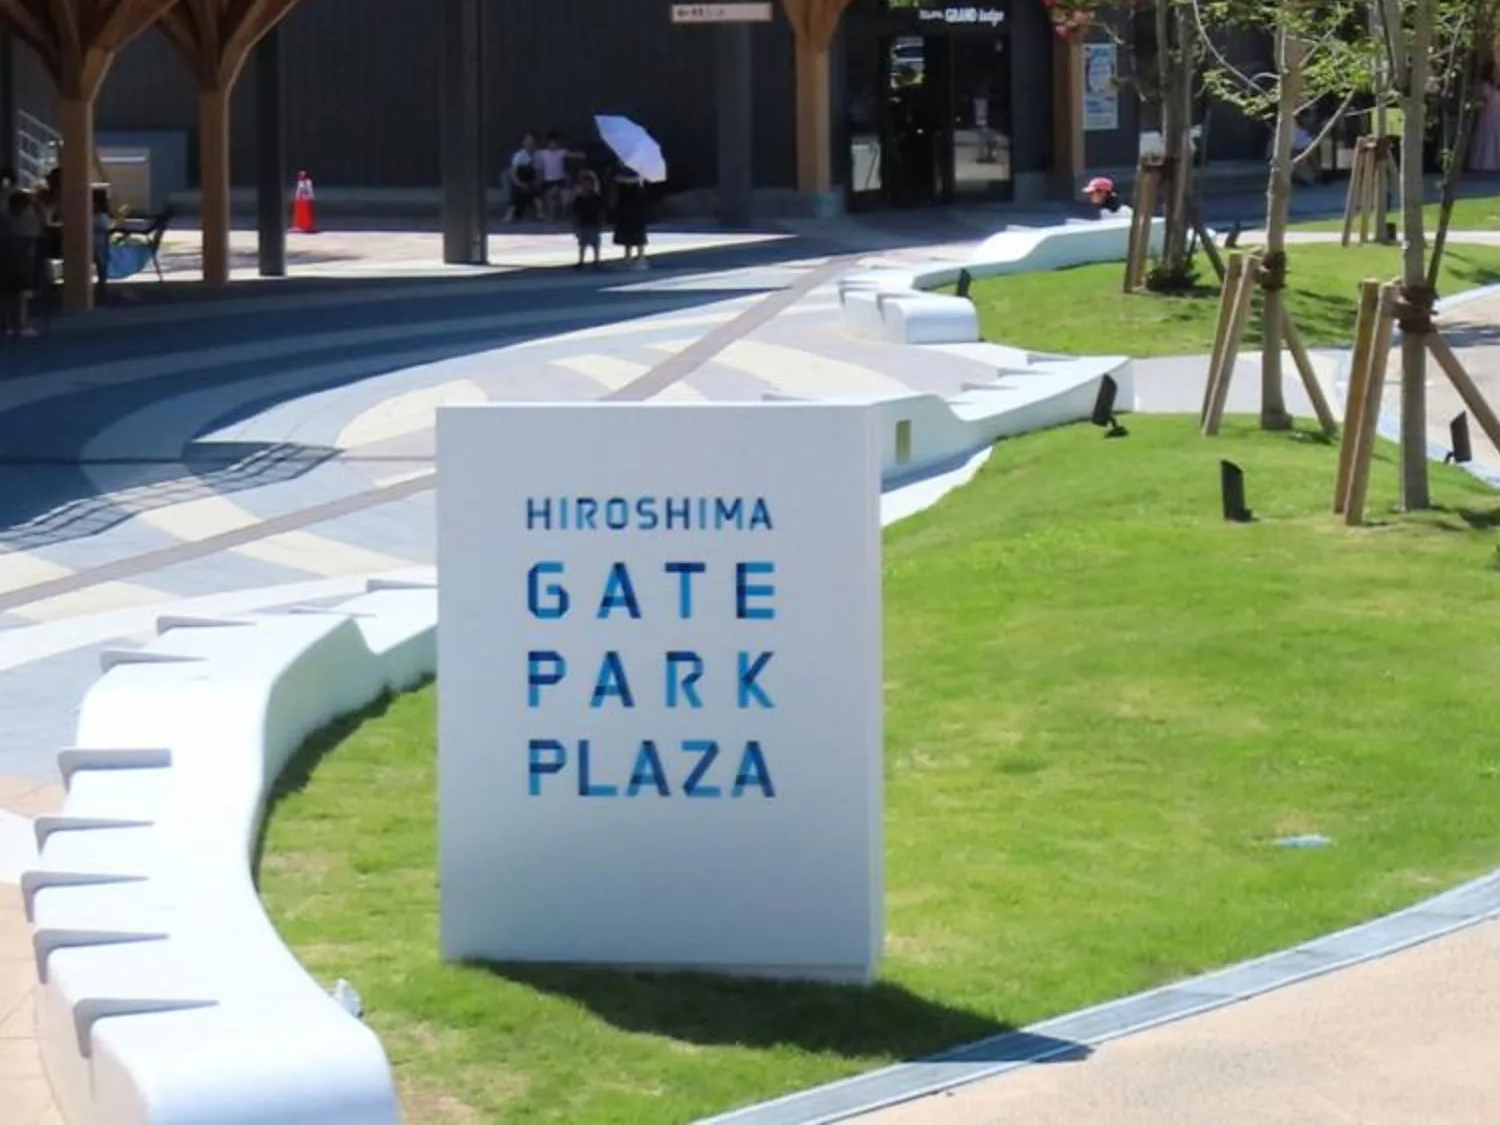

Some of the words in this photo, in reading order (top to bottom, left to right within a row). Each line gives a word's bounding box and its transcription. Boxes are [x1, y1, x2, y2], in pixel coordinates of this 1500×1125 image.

[526, 496, 773, 531] HIROSHIMA
[526, 560, 776, 621] GATE
[526, 649, 776, 710] PARK
[527, 738, 776, 800] PLAZA
